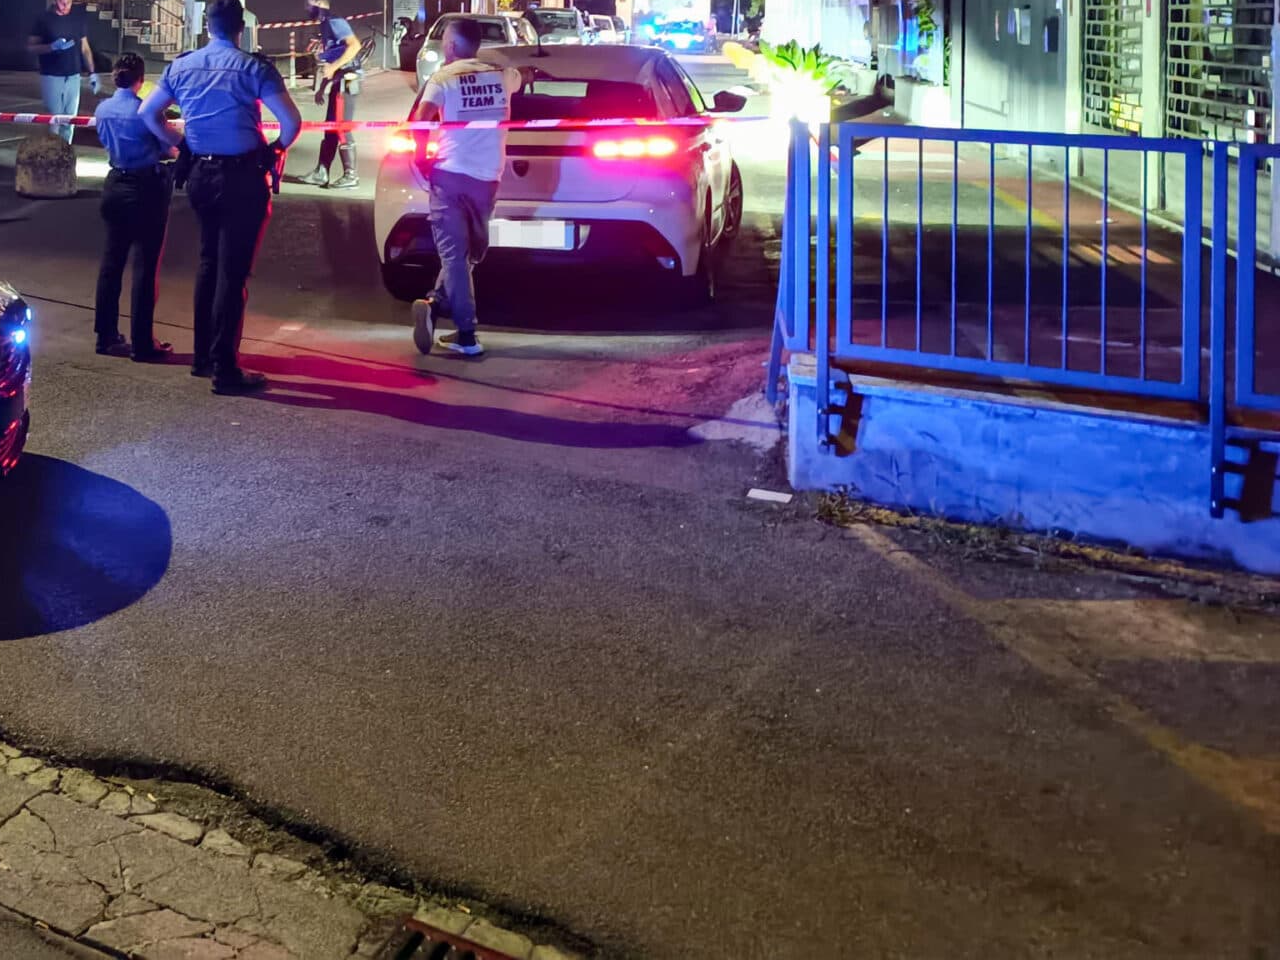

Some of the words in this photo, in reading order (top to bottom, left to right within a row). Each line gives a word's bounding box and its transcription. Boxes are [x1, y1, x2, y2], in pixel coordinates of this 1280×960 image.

[460, 75, 476, 85] NO
[461, 84, 502, 96] LIMITS
[462, 96, 494, 108] TEAM
